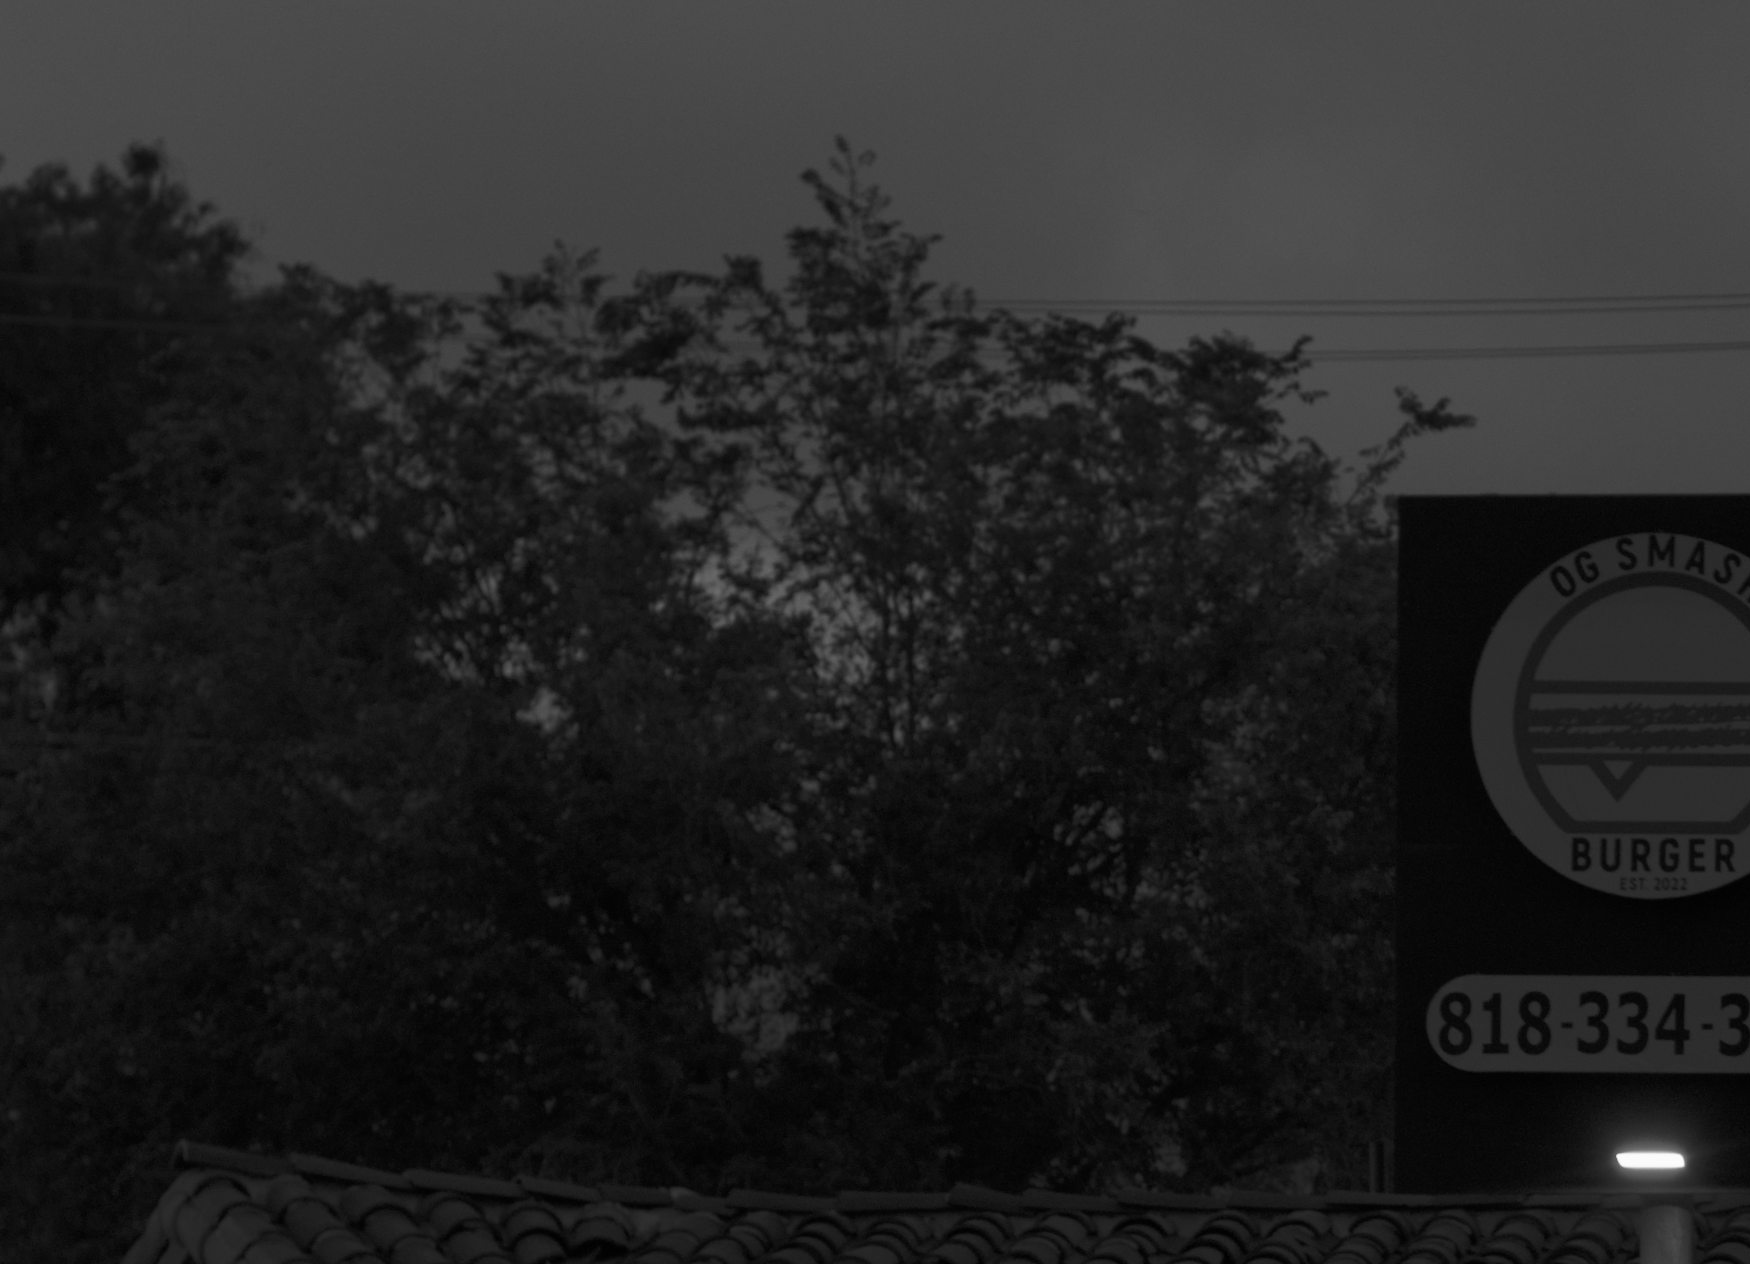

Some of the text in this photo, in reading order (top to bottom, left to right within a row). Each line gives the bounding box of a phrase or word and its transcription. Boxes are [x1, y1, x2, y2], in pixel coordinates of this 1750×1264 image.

[1549, 550, 1600, 598] OG
[1571, 837, 1736, 873] BURGER
[1653, 876, 1688, 891] 2022
